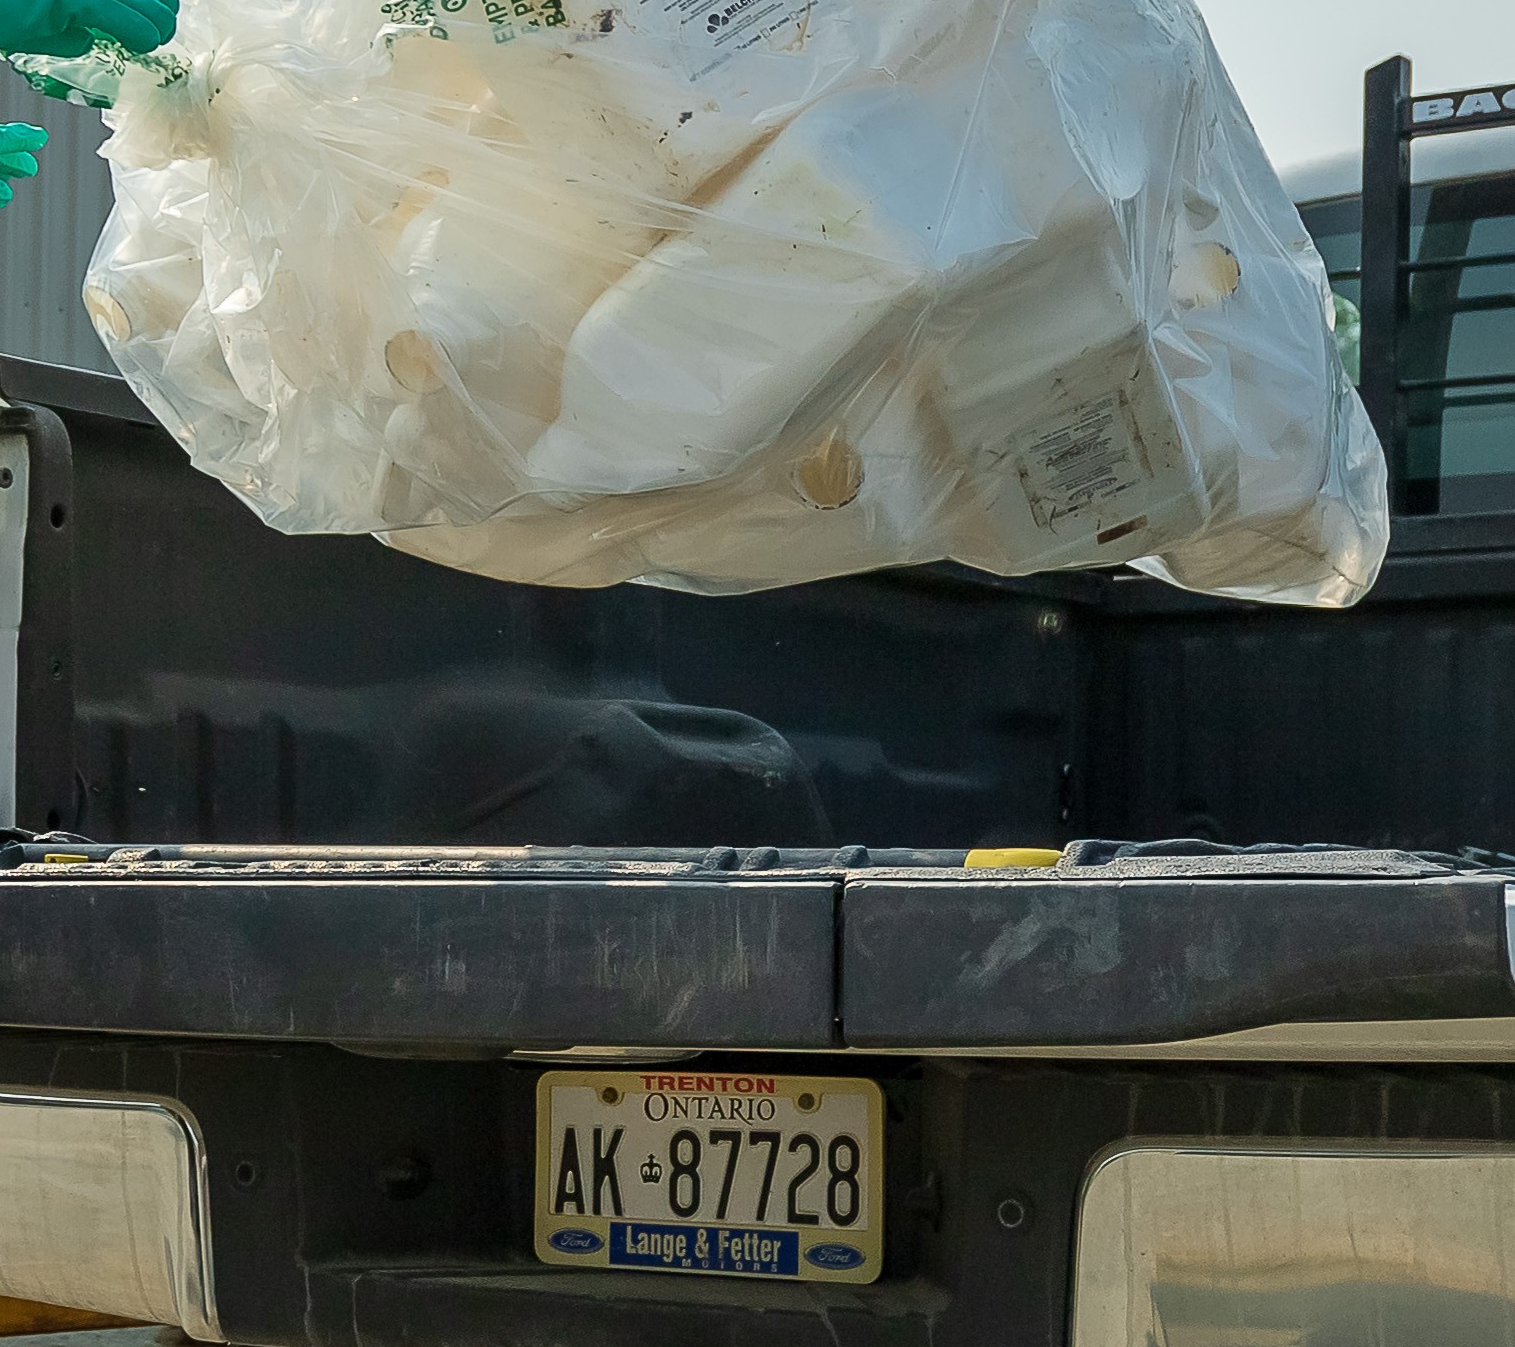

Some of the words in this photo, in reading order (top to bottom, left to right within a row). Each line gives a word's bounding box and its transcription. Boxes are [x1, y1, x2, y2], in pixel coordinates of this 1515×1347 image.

[640, 1074, 776, 1094] TRENTON
[554, 1127, 624, 1217] AK
[669, 1129, 861, 1227] 87728
[559, 1232, 592, 1248] Ford
[625, 1225, 687, 1264] Lange
[694, 1228, 710, 1259] &
[717, 1230, 782, 1263] Fetter
[817, 1246, 852, 1263] Ford
[682, 1257, 778, 1273] MOTORS
